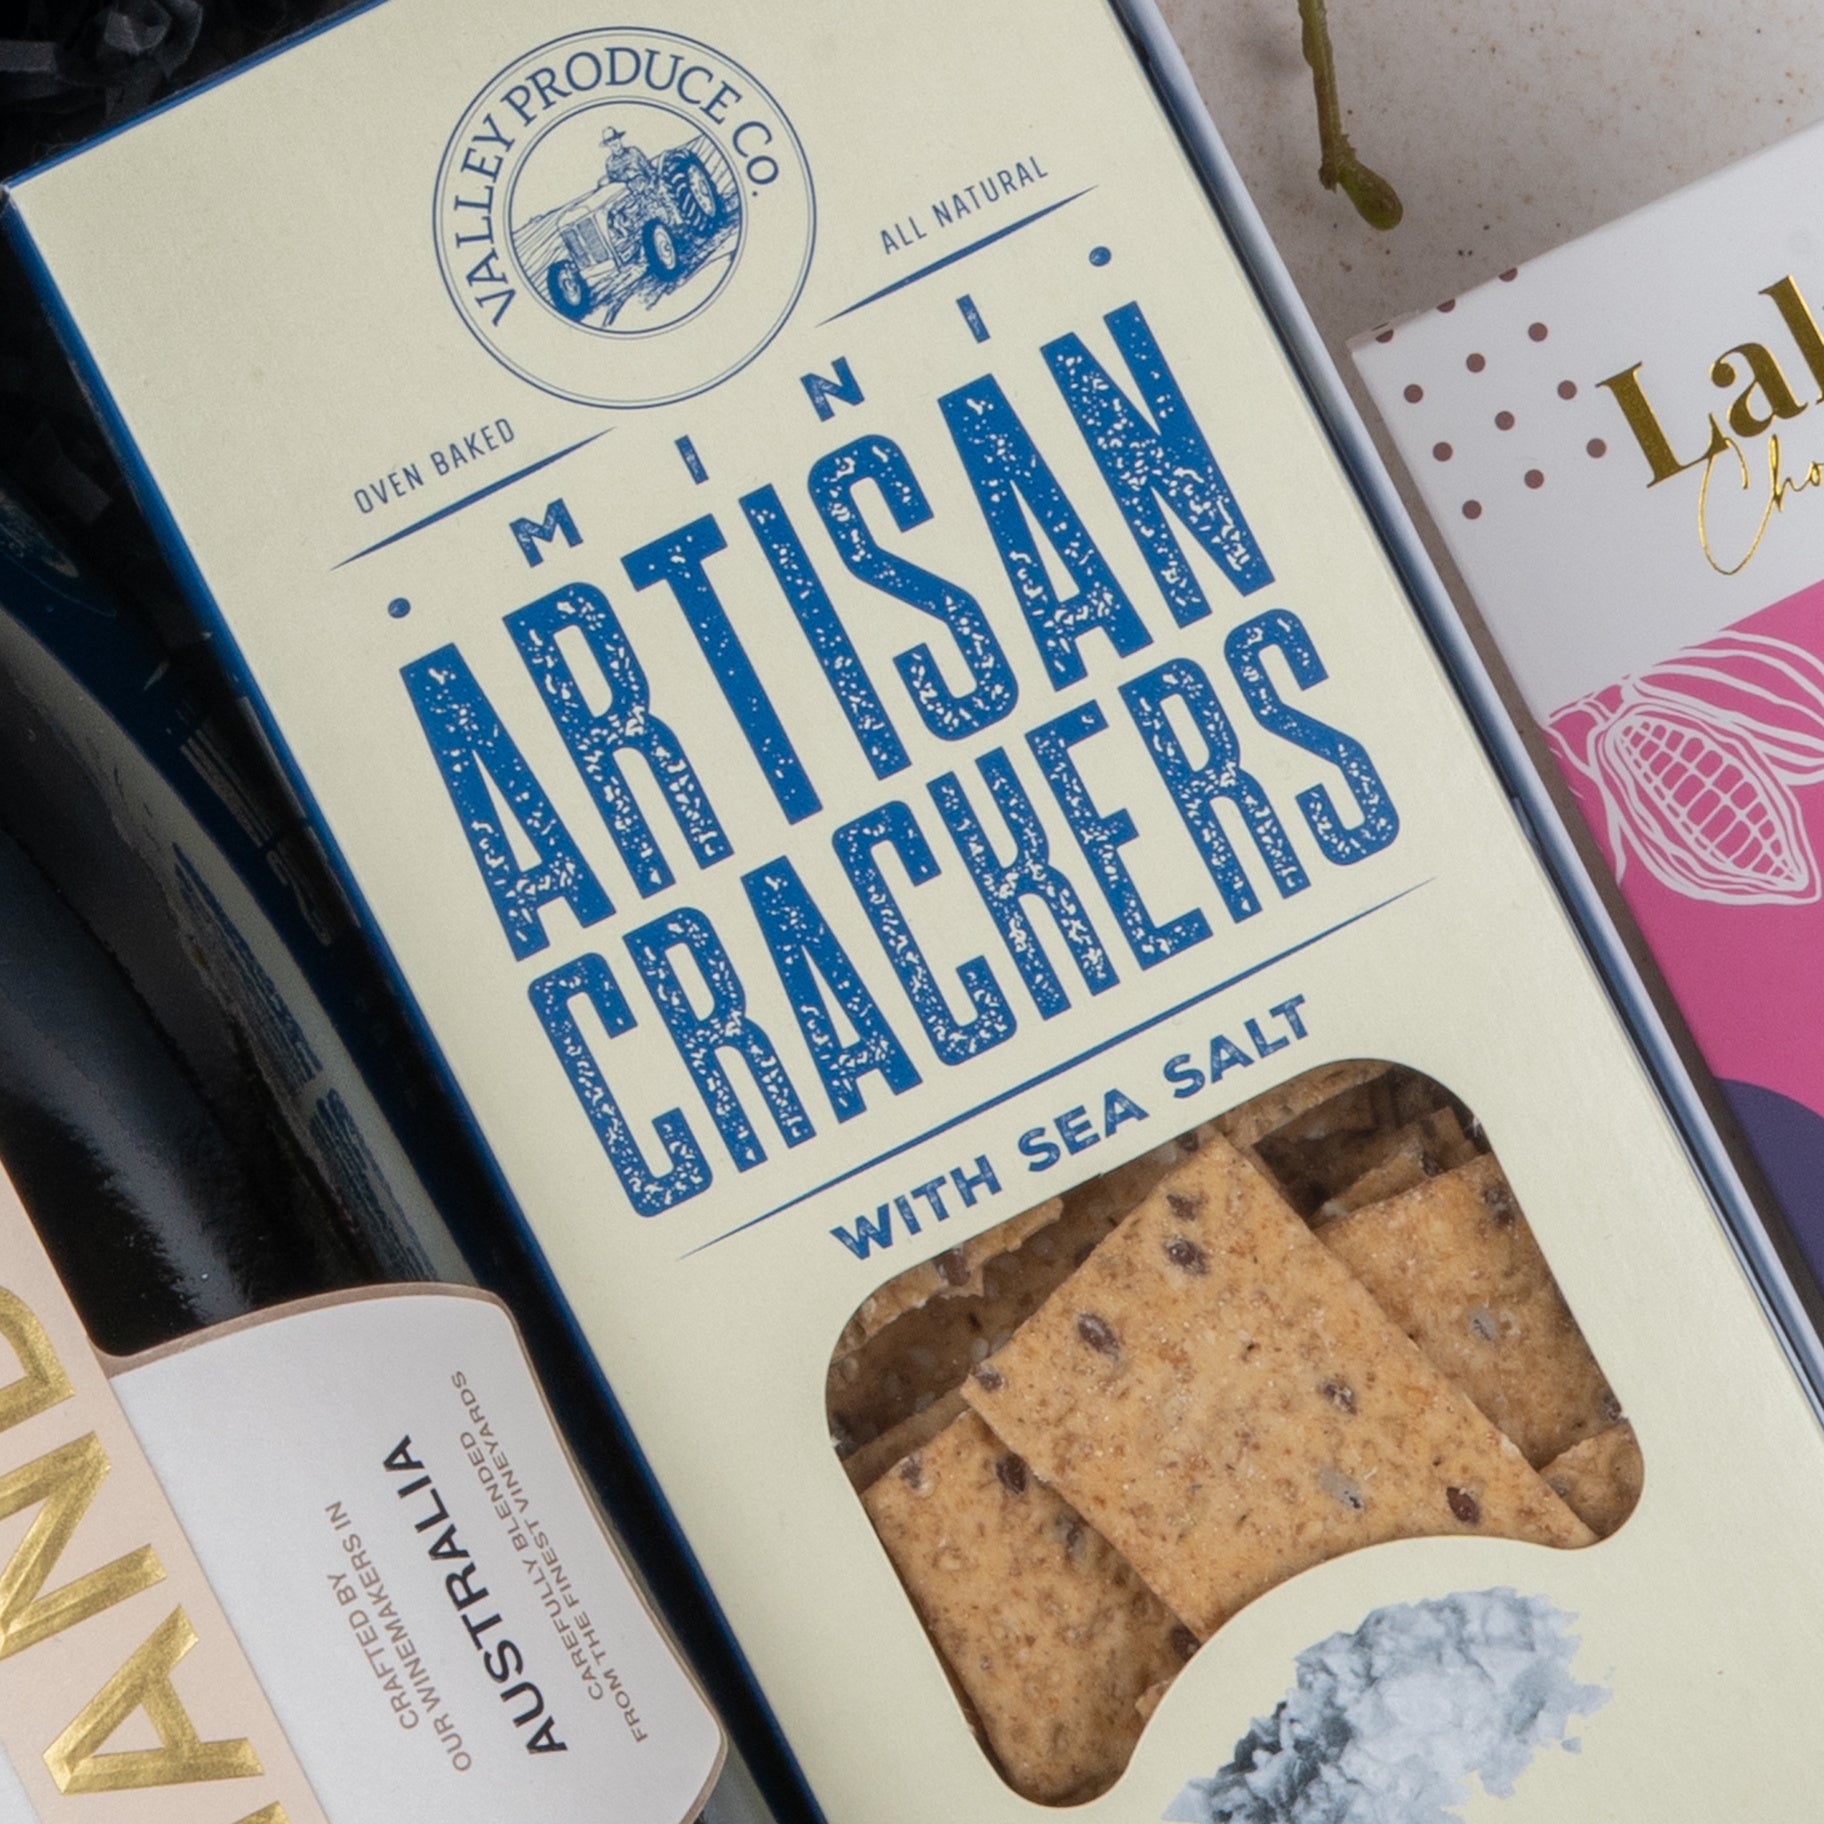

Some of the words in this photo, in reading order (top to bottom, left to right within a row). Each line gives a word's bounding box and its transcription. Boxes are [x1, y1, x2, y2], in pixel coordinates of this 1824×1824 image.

[453, 114, 516, 327] VALLEY
[500, 46, 743, 126] PRODUCE
[731, 119, 780, 197] CO.
[880, 217, 927, 255] ALL
[931, 156, 1048, 228] NATURAL
[354, 463, 424, 514] OVEN
[430, 418, 515, 476] BAKED
[399, 301, 1276, 962] ARTISAN
[528, 608, 1401, 1218] CRACKERS
[830, 1153, 1003, 1262] WITH
[1017, 1088, 1150, 1173] SEA
[1162, 994, 1315, 1100] SALT
[451, 1370, 529, 1513] VINEYARDS
[459, 1431, 529, 1552] BLENDED
[324, 1501, 354, 1531] IN
[526, 1518, 580, 1608] FINEST
[327, 1572, 358, 1607] BY
[342, 1533, 441, 1713] WINEMAKERS
[383, 1434, 568, 1755] AUSTRALIA
[522, 1557, 605, 1701] CAREFULLY
[573, 1609, 606, 1667] THE
[348, 1611, 419, 1730] CRAFTED
[598, 1668, 648, 1743] FROM
[433, 1713, 473, 1772] OUR
